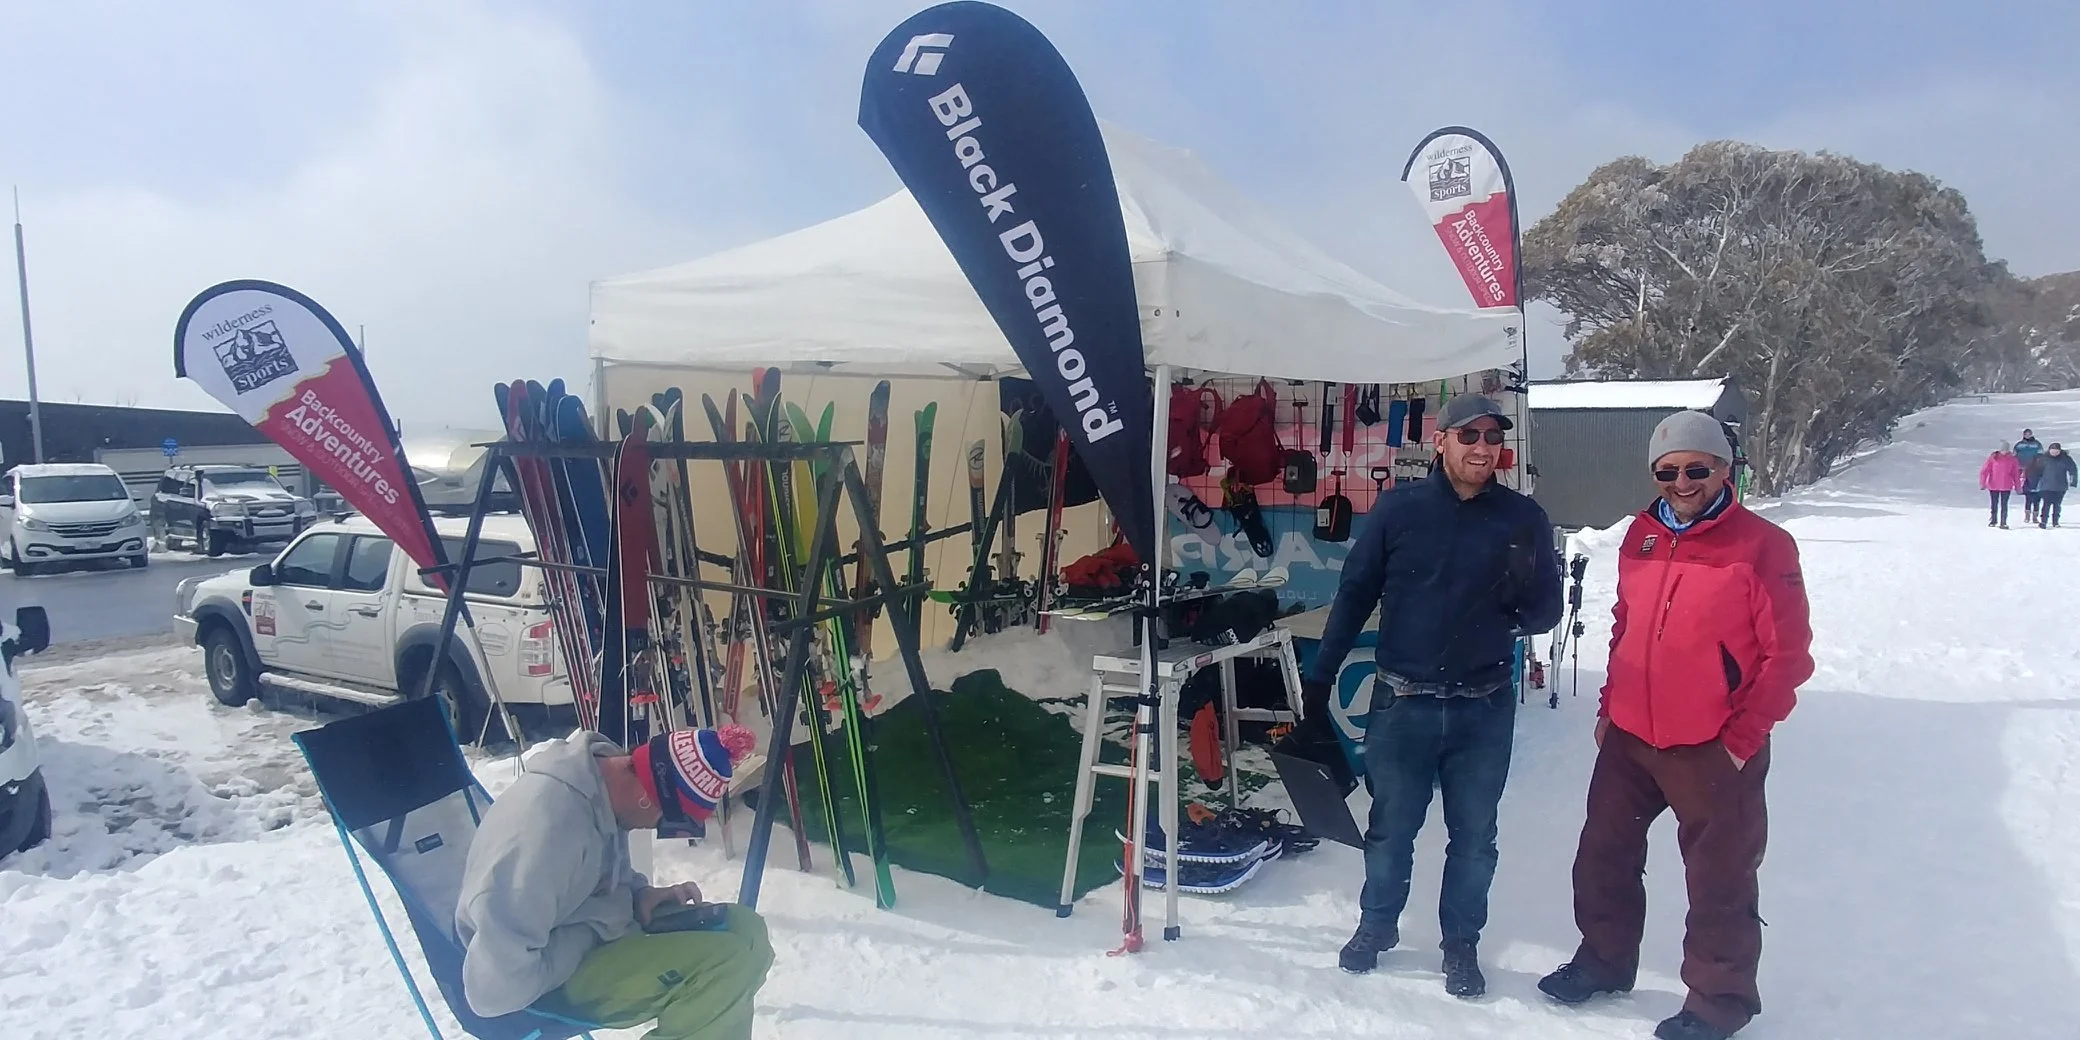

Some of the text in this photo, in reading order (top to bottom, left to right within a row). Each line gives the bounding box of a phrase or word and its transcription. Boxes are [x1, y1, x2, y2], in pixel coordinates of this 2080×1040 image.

[1426, 144, 1473, 160] wilderness
[1434, 184, 1467, 199] sports
[928, 83, 1017, 223] Black
[999, 220, 1124, 443] Diamond
[1452, 219, 1505, 302] Adventures
[1465, 209, 1504, 271] Backcountry
[202, 304, 273, 341] wilderness
[238, 359, 289, 388] sports
[284, 405, 400, 504] Adventures
[300, 389, 384, 464] Backcountry
